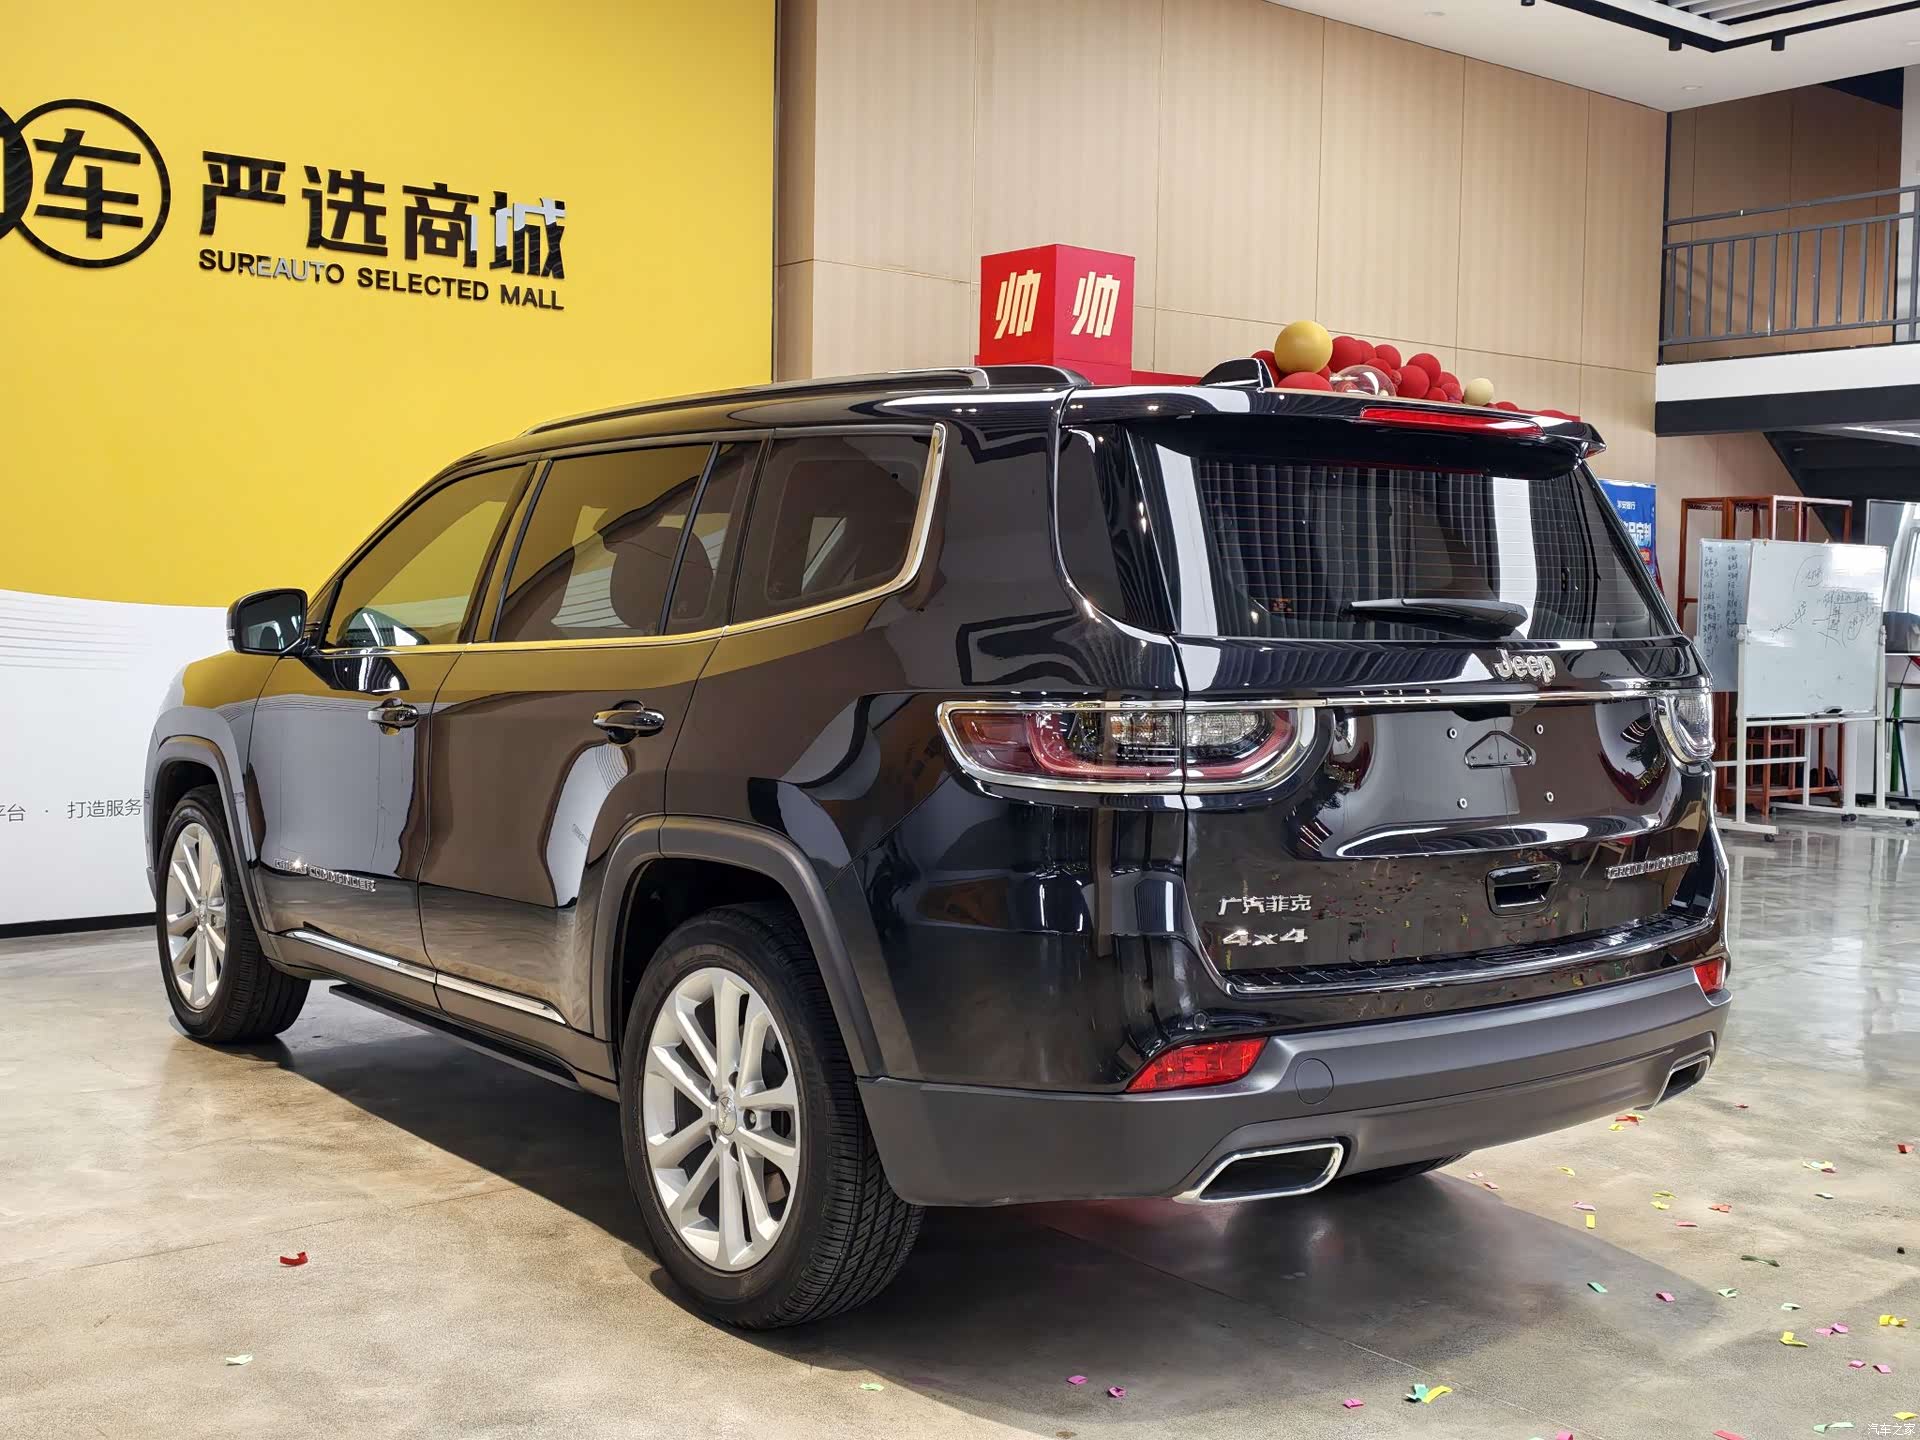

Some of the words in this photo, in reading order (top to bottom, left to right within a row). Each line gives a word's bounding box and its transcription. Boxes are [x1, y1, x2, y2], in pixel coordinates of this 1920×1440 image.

[32, 128, 143, 239] 车
[199, 150, 565, 279] 严选商城
[198, 248, 345, 284] SUREAUTO
[357, 267, 489, 301] SELECTED
[500, 284, 565, 311] MALL
[994, 269, 1042, 340] 帅
[1070, 271, 1121, 339] 帅
[1493, 647, 1556, 686] Jeep
[67, 798, 143, 819] 打造服务
[1218, 894, 1312, 916] 广汽菲克
